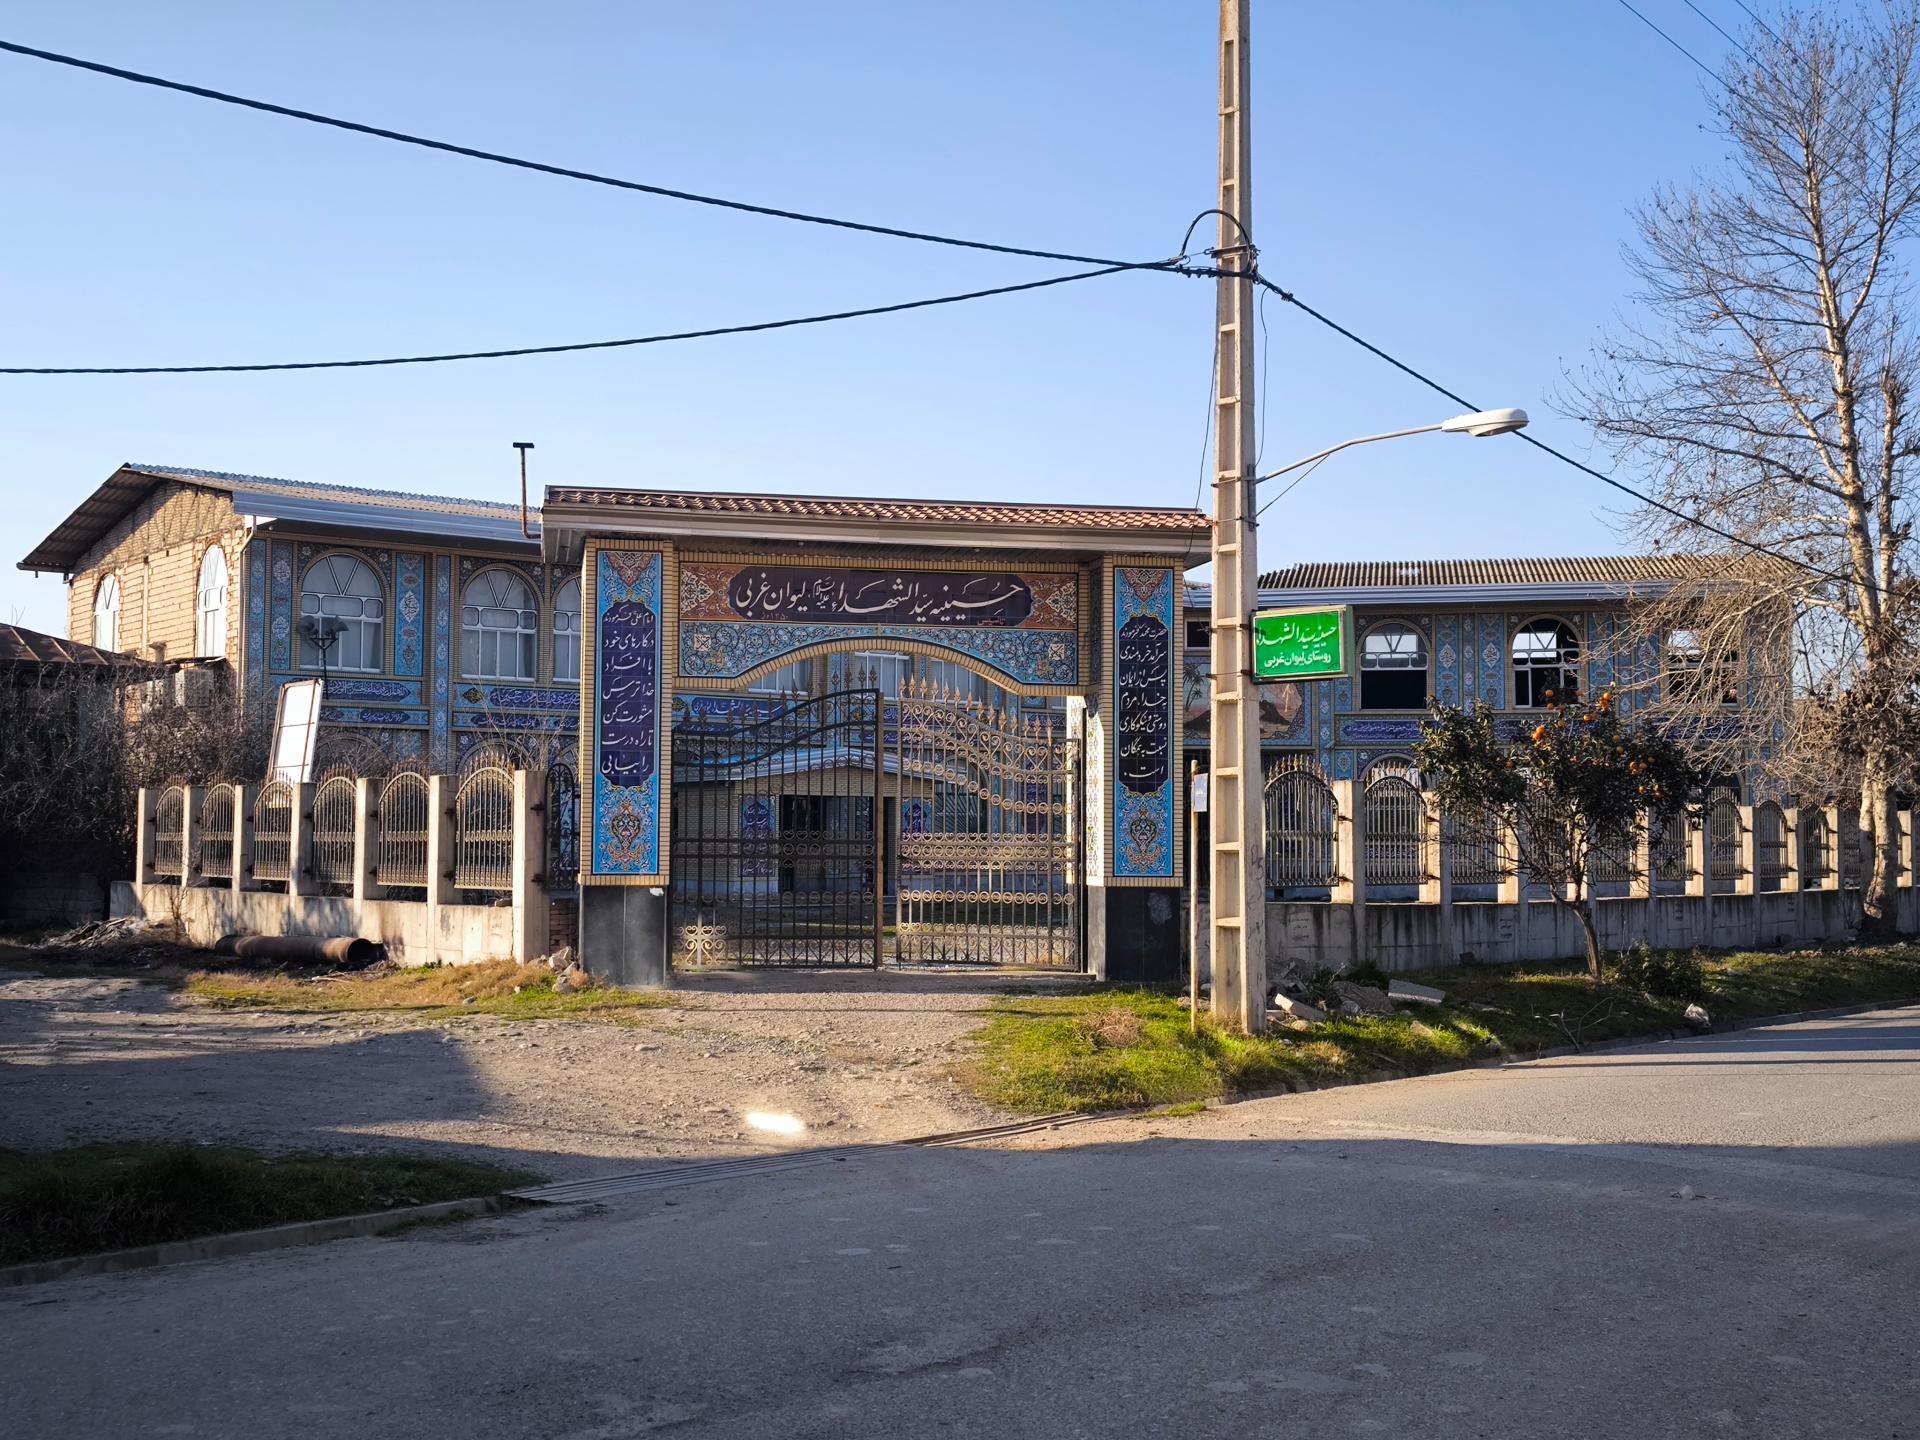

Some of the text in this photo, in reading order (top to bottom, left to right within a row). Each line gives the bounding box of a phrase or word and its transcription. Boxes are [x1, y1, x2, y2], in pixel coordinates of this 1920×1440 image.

[735, 572, 772, 617] غربی
[763, 580, 808, 612] لیوان
[604, 630, 620, 648] خود
[605, 654, 652, 675] با افراد
[1264, 650, 1331, 668] روستای لیوان غربی
[1135, 669, 1145, 685] از
[1121, 692, 1137, 711] مردم
[603, 700, 628, 724] کن
[616, 704, 652, 723] مشورت
[602, 729, 653, 746] تا راه درست
[1146, 737, 1167, 755] نسبت
[642, 756, 649, 772] را
